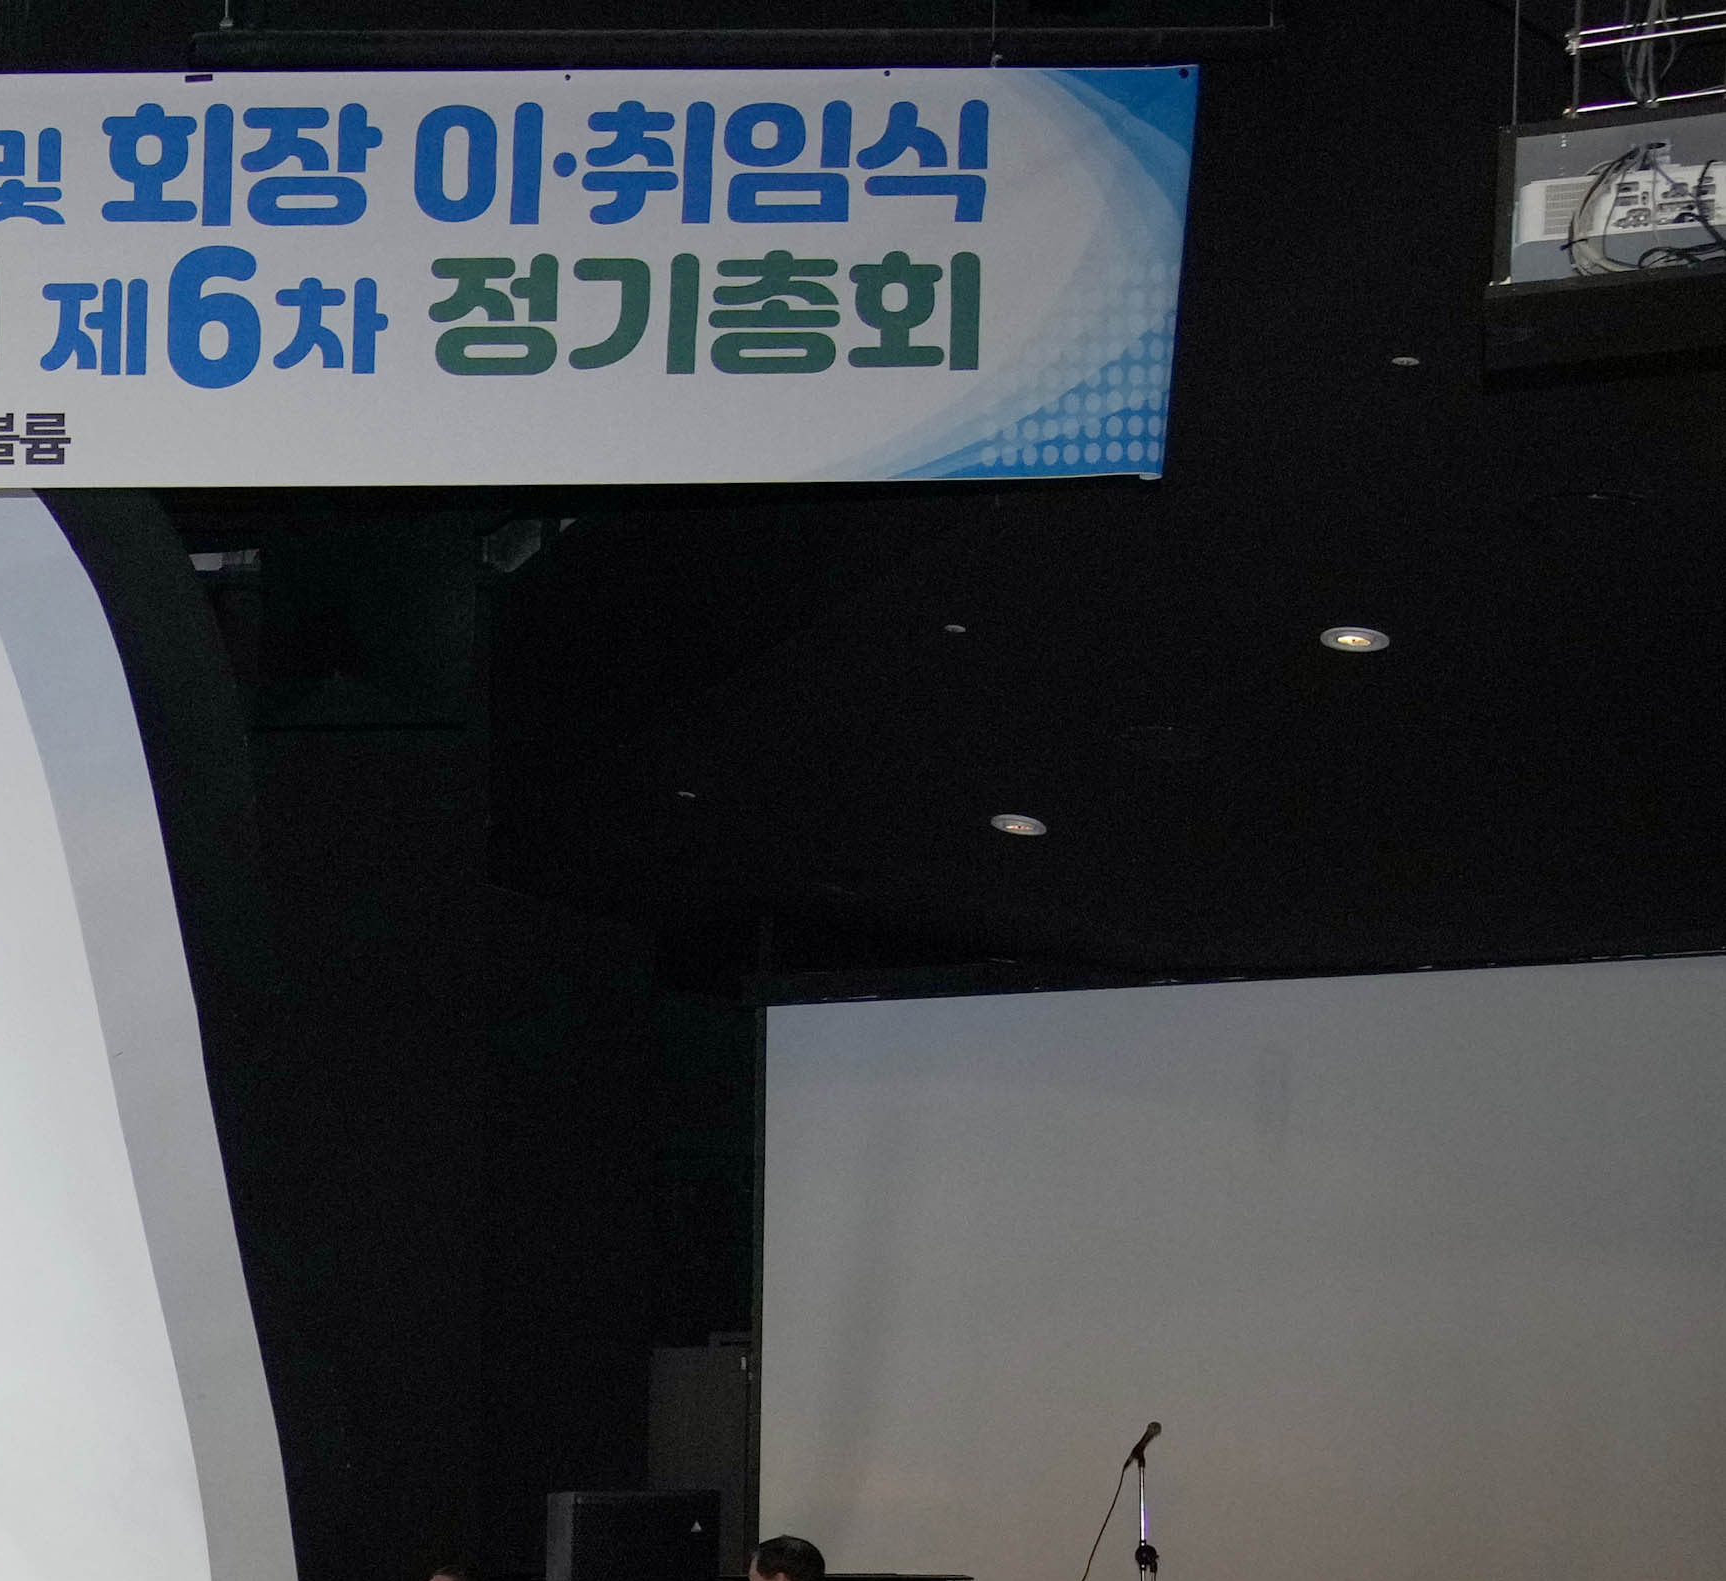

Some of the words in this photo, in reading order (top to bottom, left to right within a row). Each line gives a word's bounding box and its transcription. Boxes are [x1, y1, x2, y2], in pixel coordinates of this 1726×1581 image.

[102, 103, 382, 226] 회장
[415, 100, 989, 224] 이·취임식
[40, 245, 388, 389] 제6차
[429, 250, 980, 375] 정기총회
